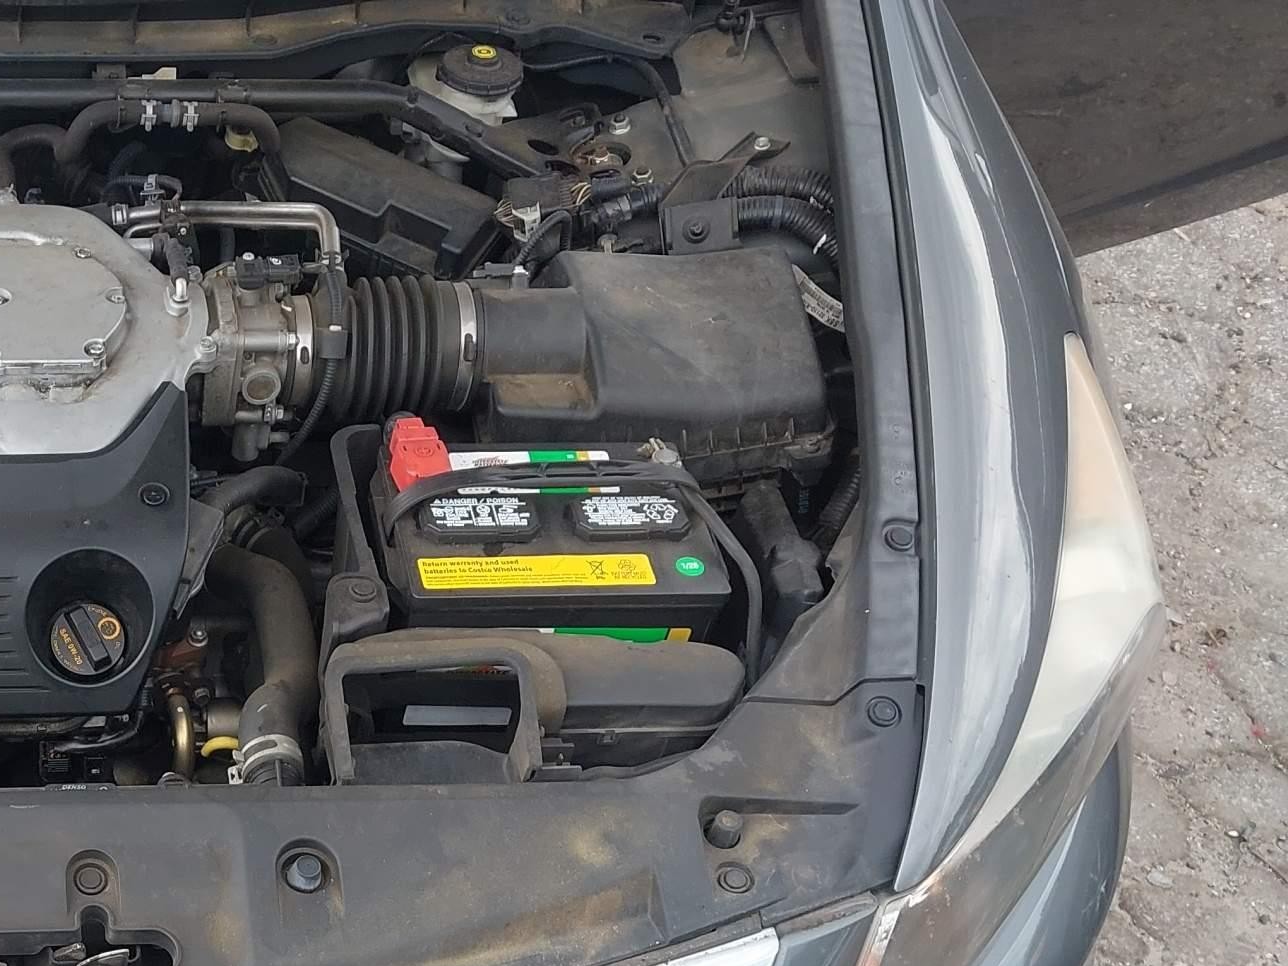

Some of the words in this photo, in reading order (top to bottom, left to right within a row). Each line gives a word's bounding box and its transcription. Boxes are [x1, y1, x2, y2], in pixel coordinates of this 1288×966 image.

[493, 565, 533, 573] Wholesale
[59, 628, 72, 644] SAE
[67, 643, 83, 665] 0W-20
